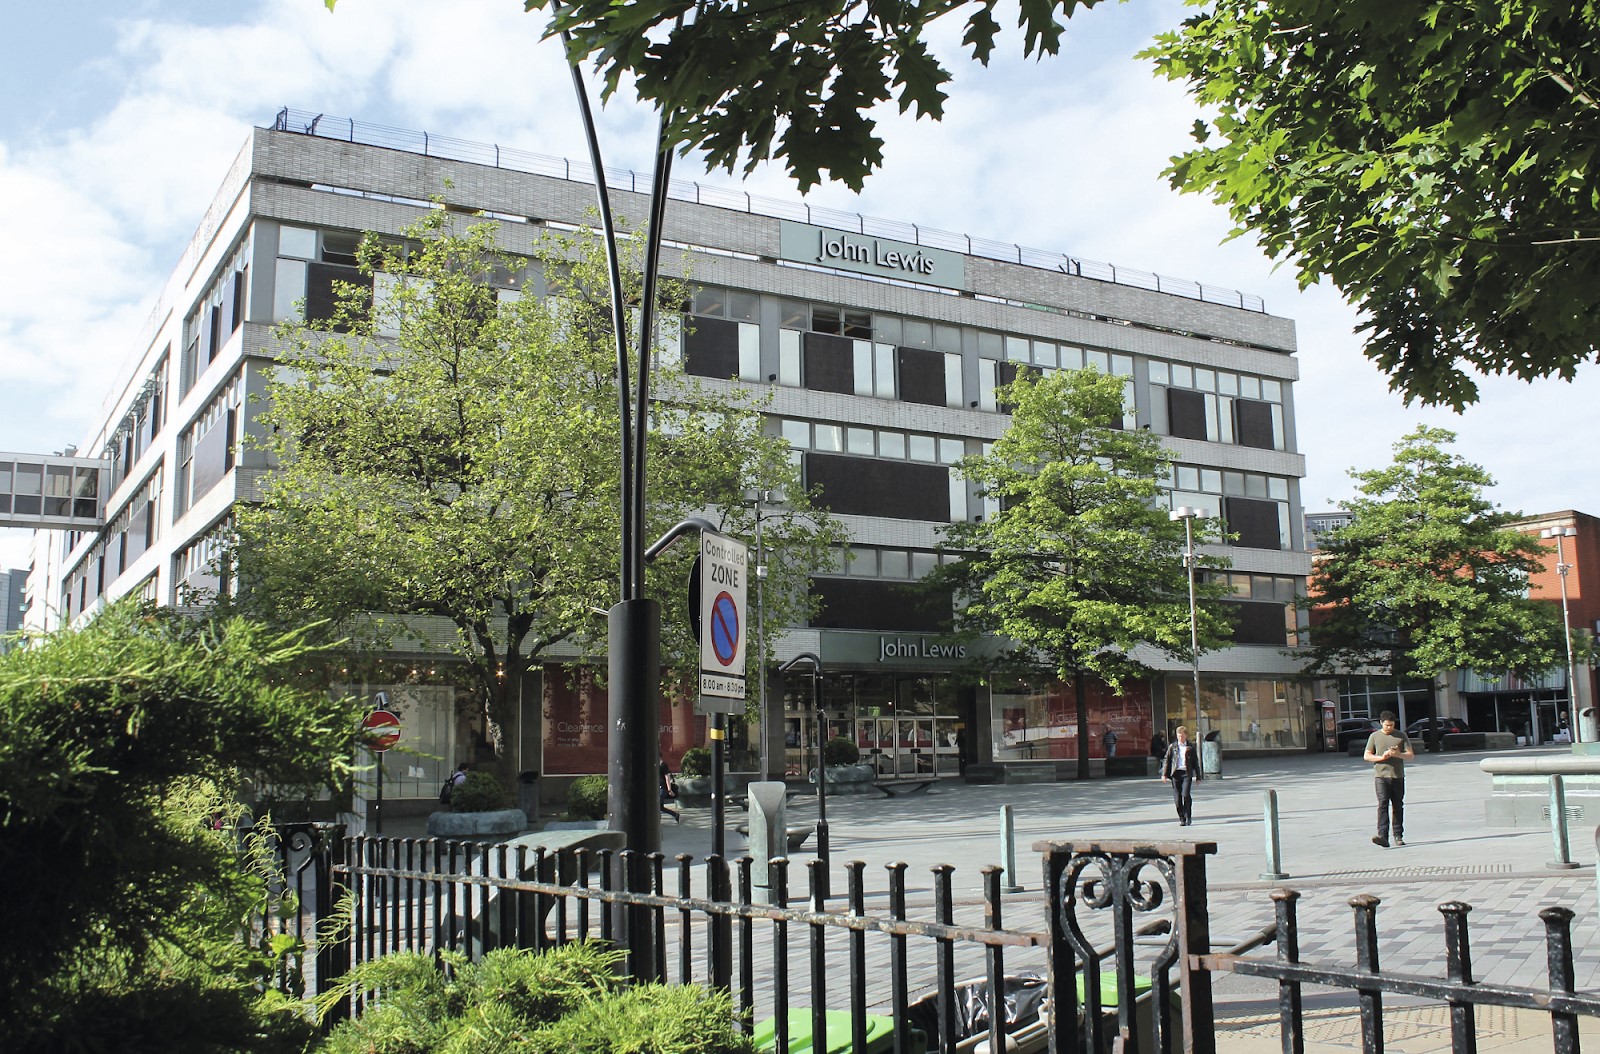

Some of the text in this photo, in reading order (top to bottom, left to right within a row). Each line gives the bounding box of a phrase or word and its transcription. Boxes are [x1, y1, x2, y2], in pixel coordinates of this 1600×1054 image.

[816, 230, 935, 275] John Lewis
[705, 539, 745, 566] Controlled
[711, 562, 739, 588] ZONE
[879, 637, 965, 661] John Lewis
